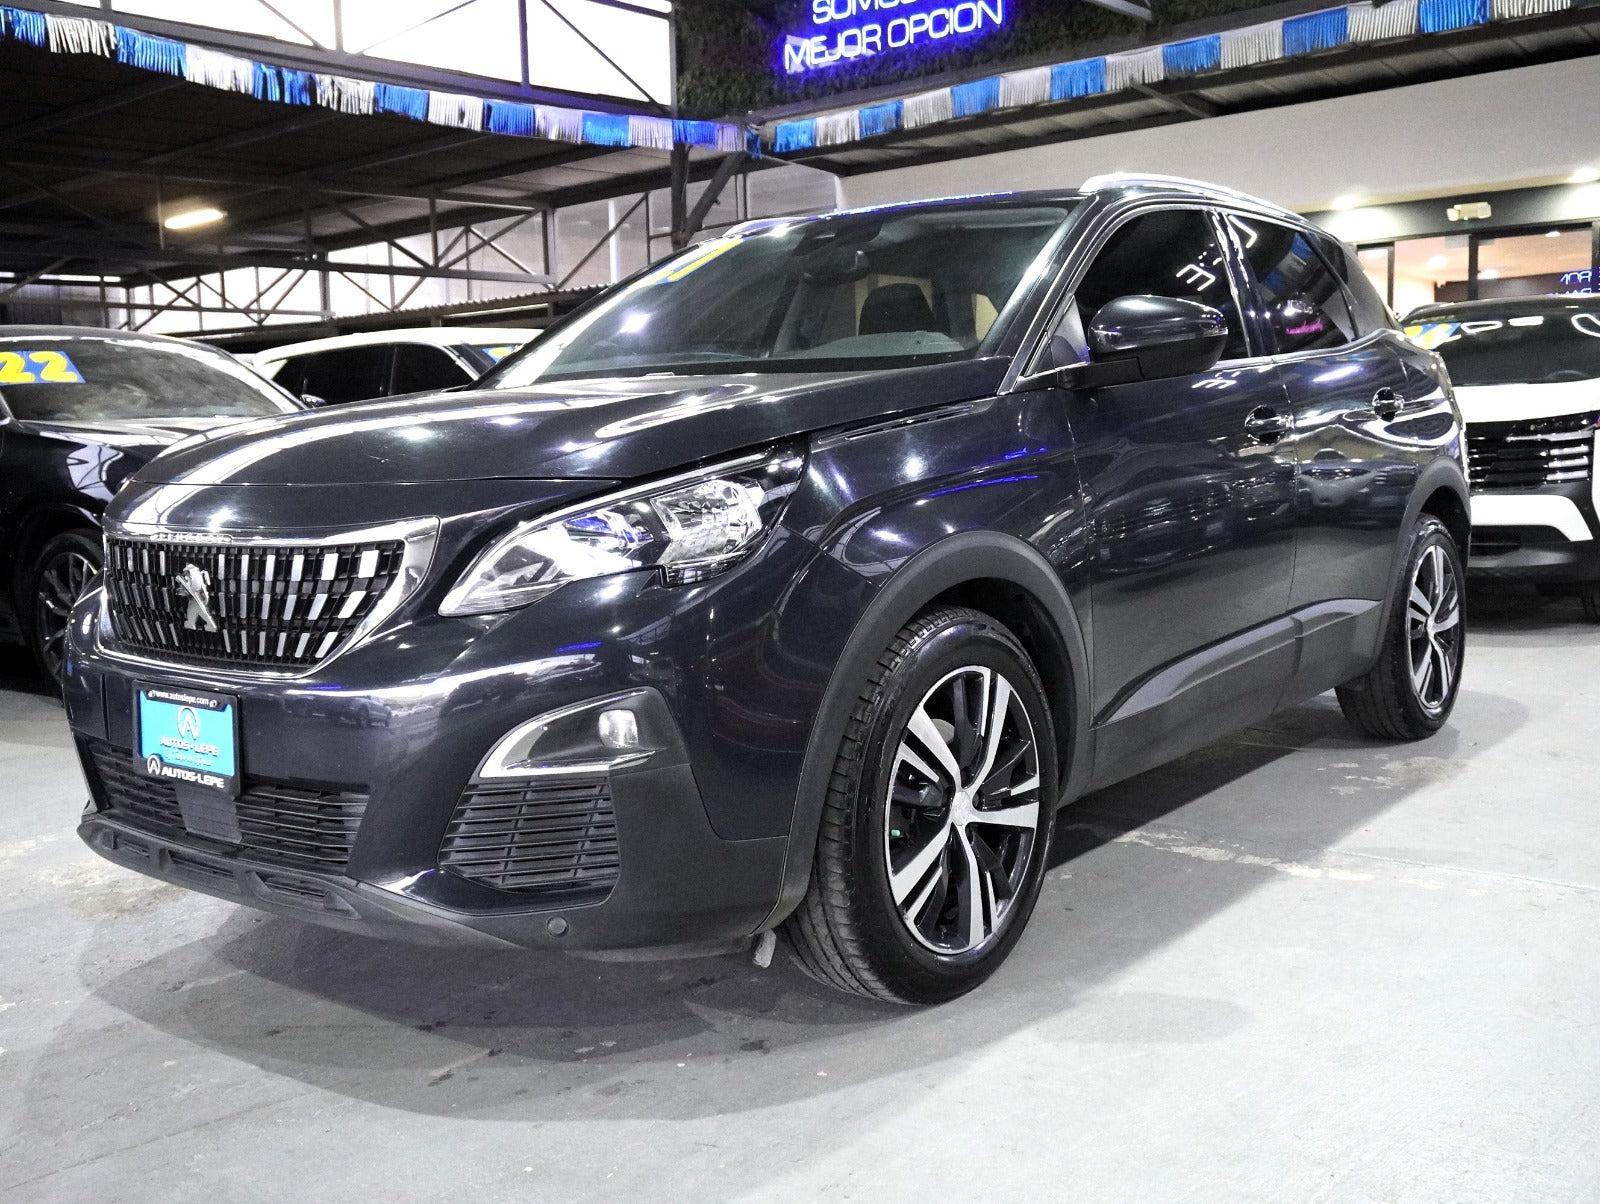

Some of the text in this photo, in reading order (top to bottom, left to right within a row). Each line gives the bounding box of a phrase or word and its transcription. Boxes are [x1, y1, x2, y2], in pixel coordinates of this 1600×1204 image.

[784, 0, 1003, 70] MEJOR OPCION
[155, 690, 209, 705] www.autoslepe.com
